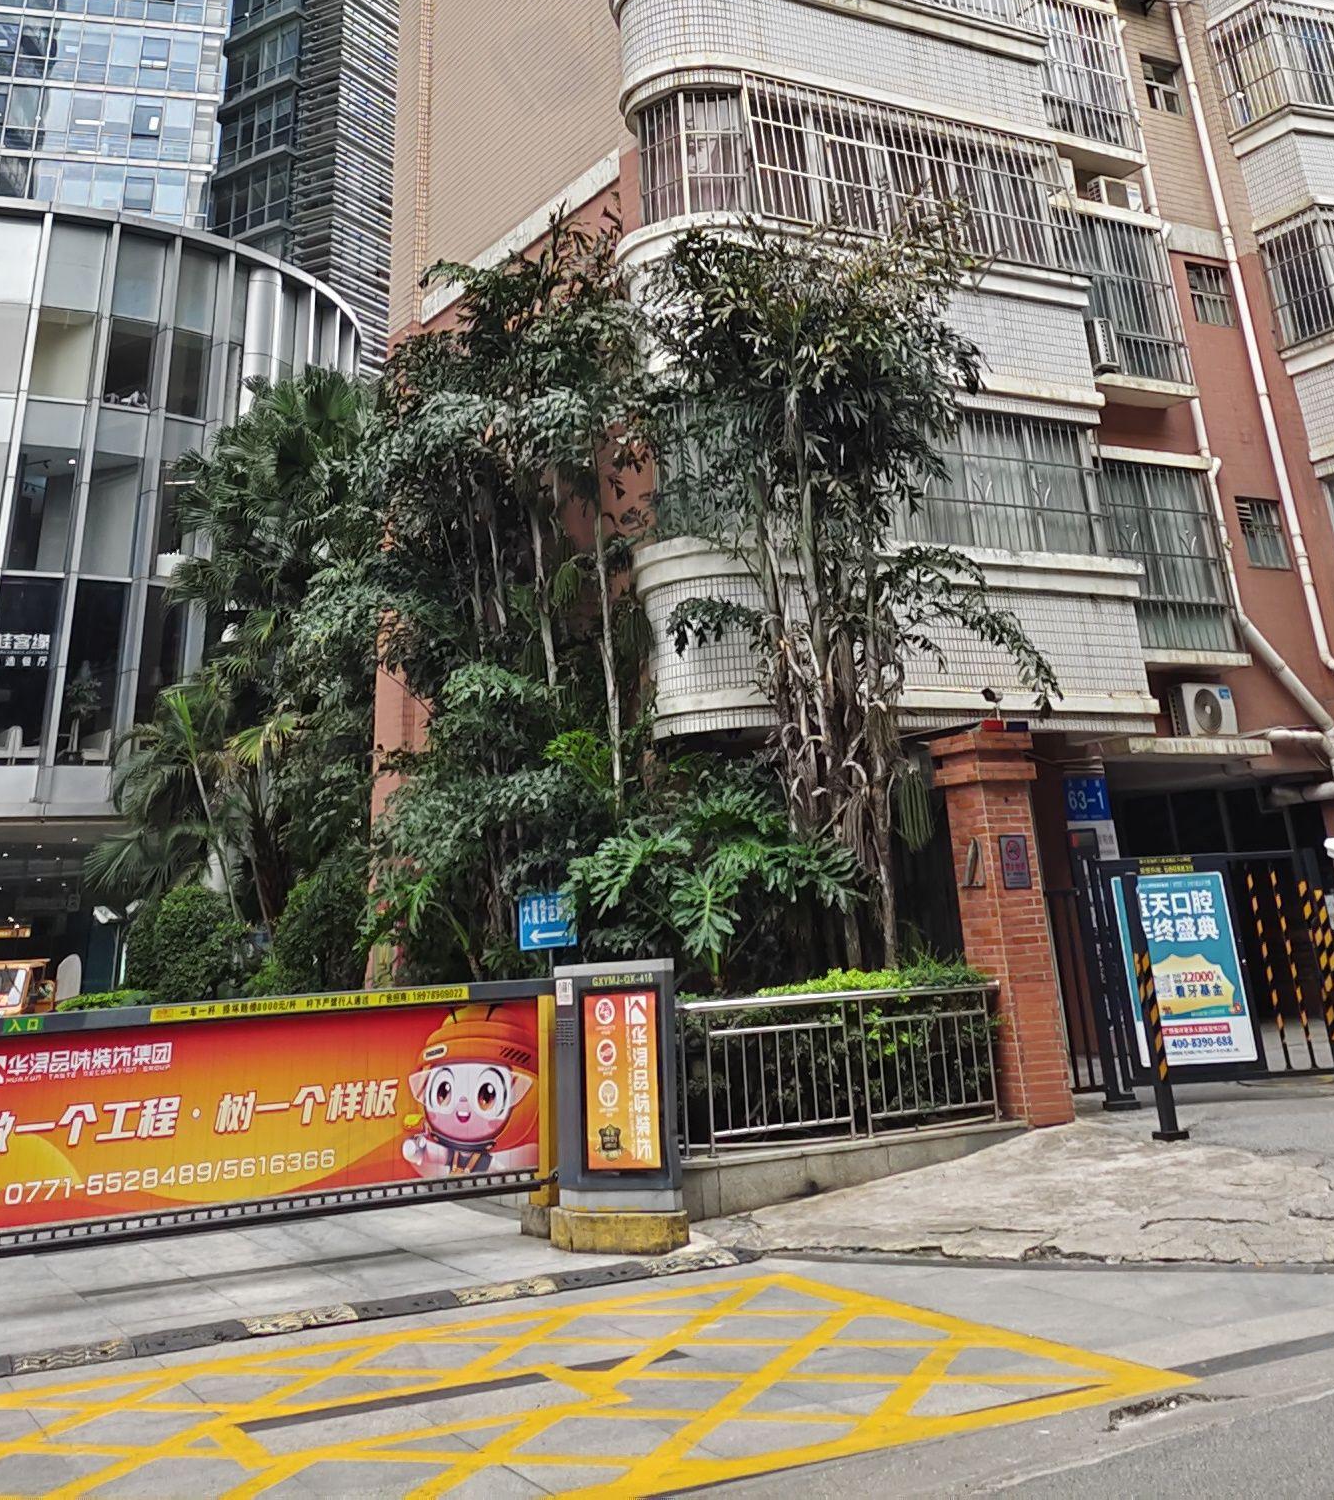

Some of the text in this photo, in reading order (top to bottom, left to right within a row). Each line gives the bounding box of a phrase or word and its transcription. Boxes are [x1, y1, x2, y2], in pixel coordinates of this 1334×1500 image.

[1067, 788, 1105, 810] 63-1
[1181, 971, 1215, 983] 22000
[8, 1020, 38, 1032] 入口
[7, 1042, 173, 1075] 华浔品味装饰集团
[4, 1149, 335, 1206] 0771-5528489/5616366
